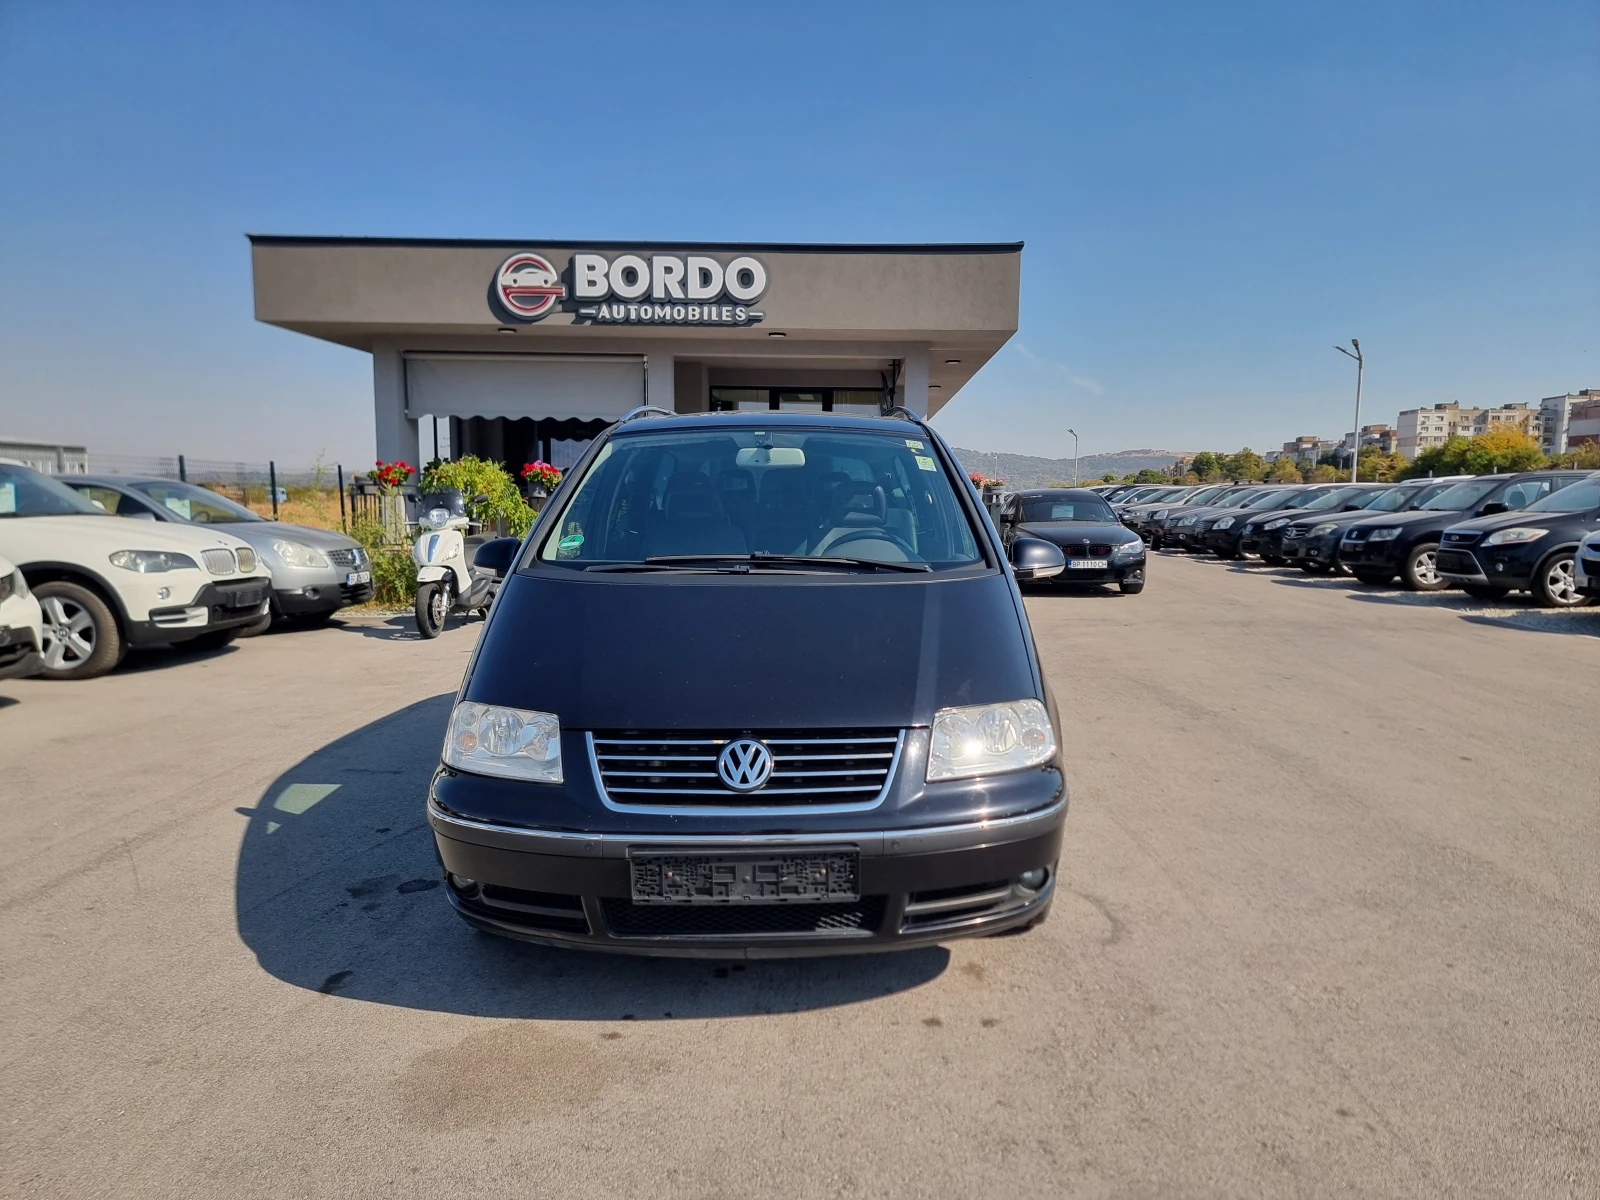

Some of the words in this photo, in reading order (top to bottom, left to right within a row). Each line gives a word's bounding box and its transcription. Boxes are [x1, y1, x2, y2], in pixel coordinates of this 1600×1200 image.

[575, 254, 767, 300] BORDO
[598, 305, 747, 321] AUTOMOBILES
[719, 739, 770, 789] VW
